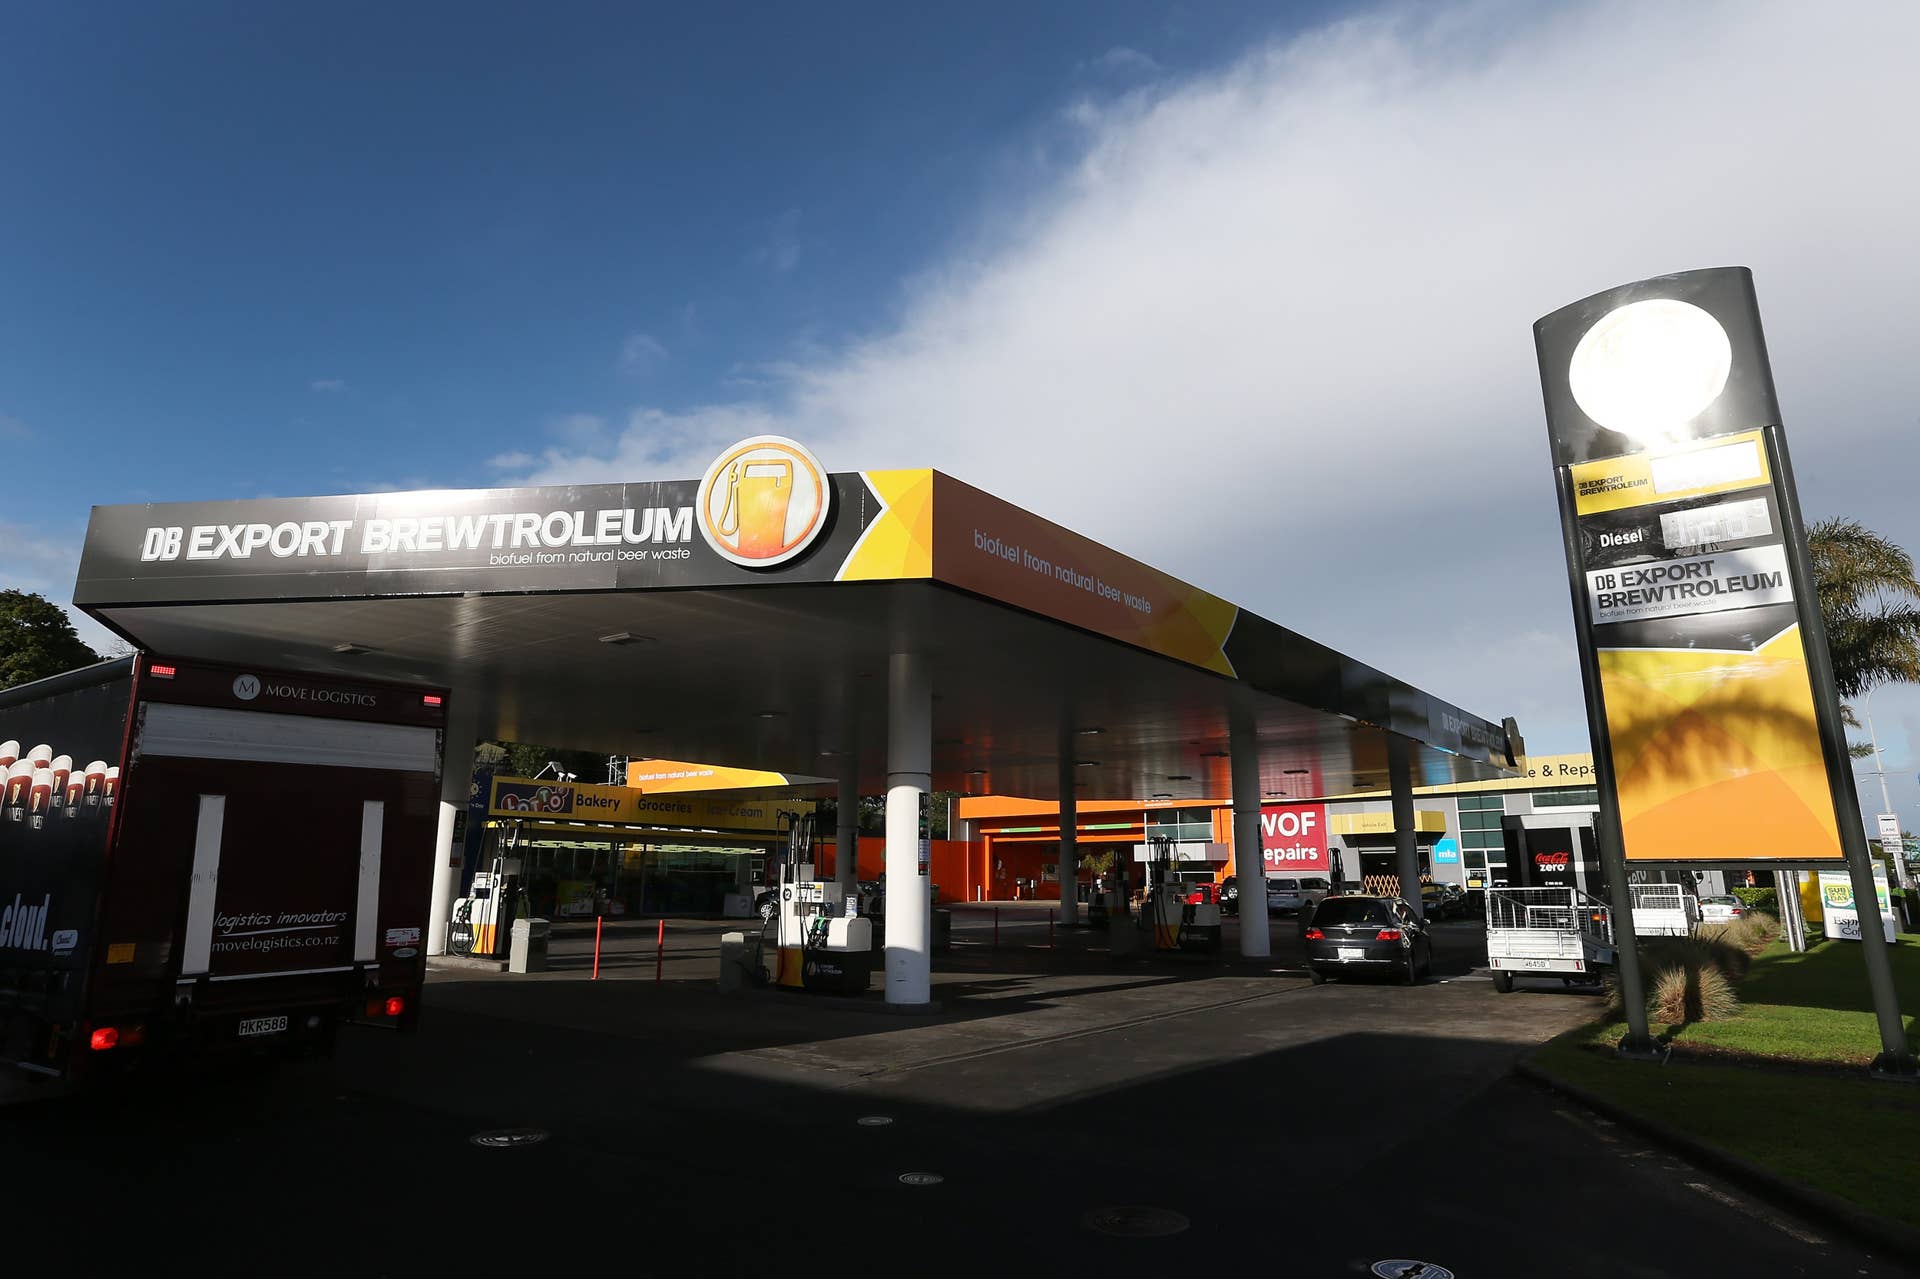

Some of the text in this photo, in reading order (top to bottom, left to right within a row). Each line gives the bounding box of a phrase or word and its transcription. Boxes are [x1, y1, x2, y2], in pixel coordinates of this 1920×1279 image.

[1579, 478, 1648, 497] BREWTROLEUM
[1589, 475, 1624, 488] EXPORT
[142, 506, 694, 562] DB EXPORT BREWTROLEUM
[1599, 528, 1644, 548] Diesel
[490, 547, 691, 566] biofuel from natural beer waste
[974, 528, 1152, 614] biofuel from natural beer waste
[1595, 559, 1715, 591] DB EXPORT
[1597, 571, 1784, 609] BREWTROLEUM
[1599, 609, 1625, 619] biofuel
[1625, 606, 1643, 615] from
[239, 681, 254, 694] M
[265, 684, 377, 707] MOVE LOGISTICS
[1543, 765, 1553, 777] &
[1559, 763, 1596, 778] Repa
[576, 794, 620, 811] Bakery
[638, 798, 693, 814] Groceries
[1263, 842, 1318, 866] epairs
[1539, 863, 1565, 872] zero
[214, 909, 348, 934] logistics innovators
[1833, 916, 1860, 928] Espr
[211, 934, 340, 953] movelogistics.co.nz
[240, 1017, 287, 1034] HKR588
